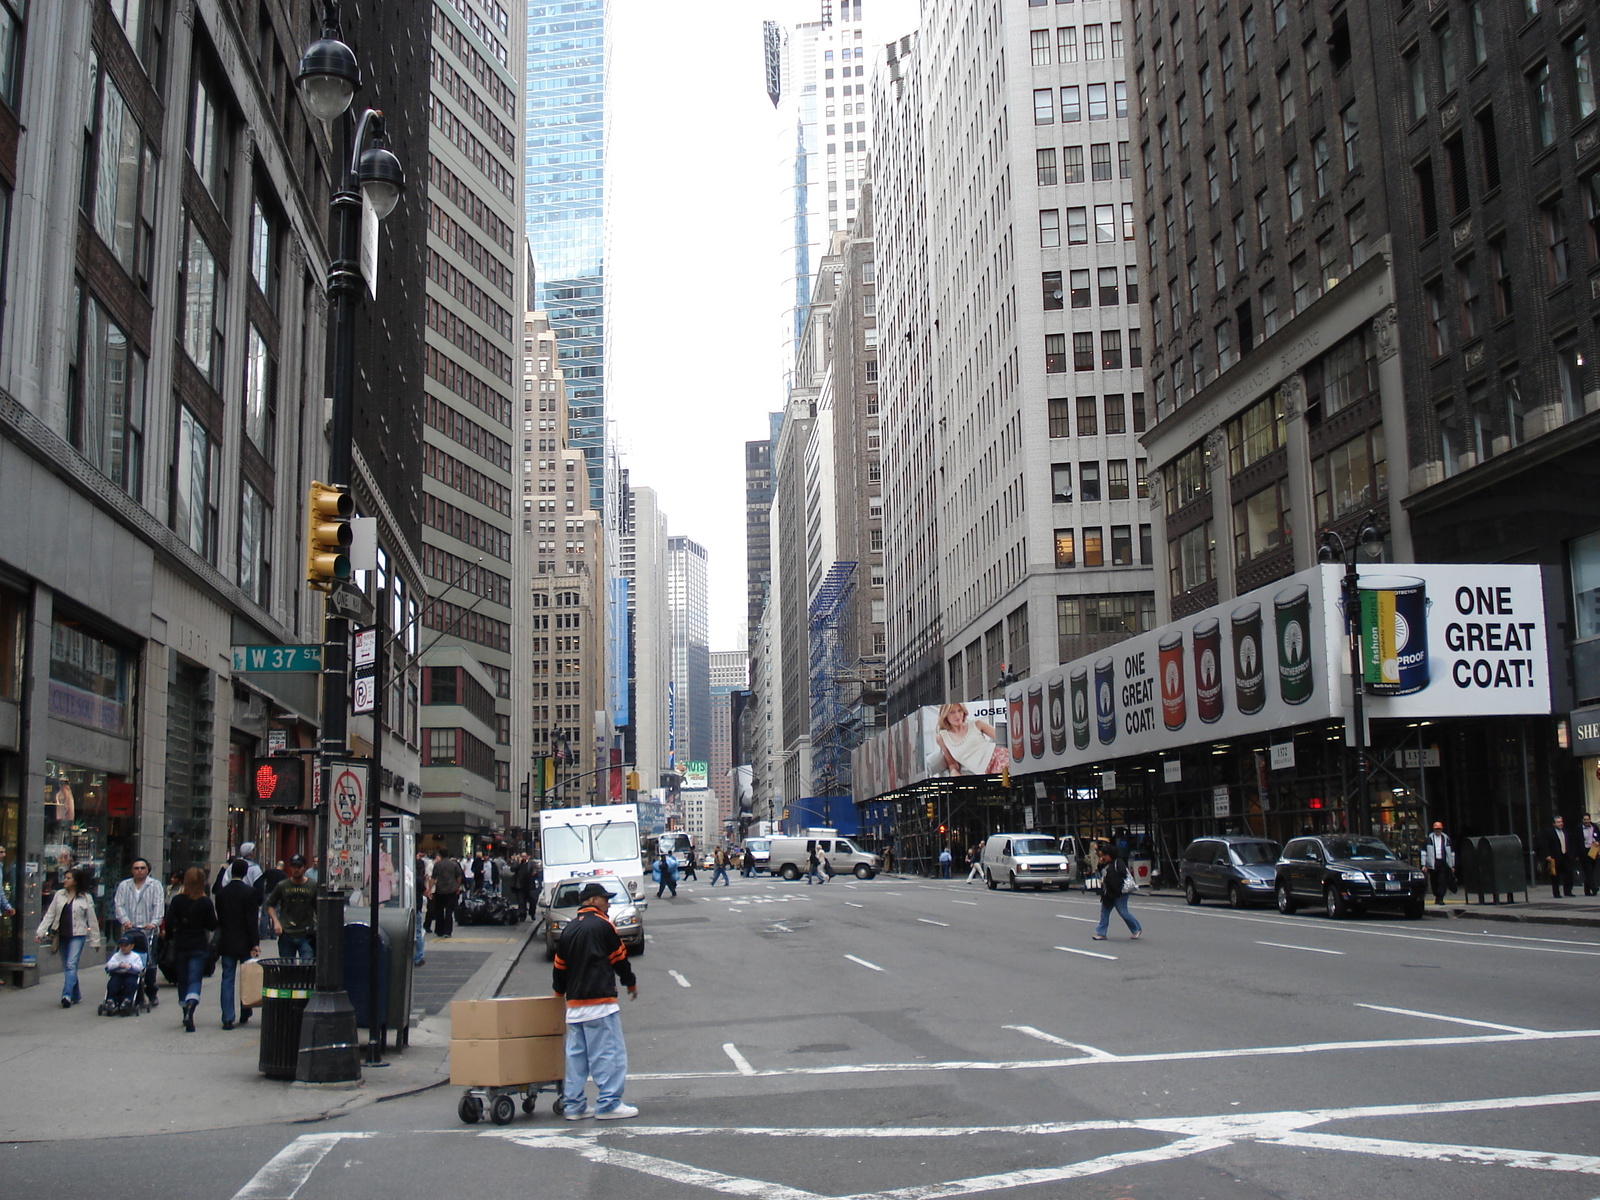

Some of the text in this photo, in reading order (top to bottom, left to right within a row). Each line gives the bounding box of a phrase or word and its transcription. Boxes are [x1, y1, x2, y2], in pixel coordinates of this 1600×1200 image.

[1369, 596, 1378, 627] district
[1455, 586, 1513, 615] ONE
[1370, 626, 1380, 665] fashion
[1445, 622, 1535, 652] GREAT
[251, 648, 318, 669] W 37 ST
[1125, 651, 1145, 679] ONE
[1280, 658, 1310, 676] WEATHERPROOF
[1452, 658, 1534, 688] COAT!
[1122, 677, 1154, 708] GREAT
[1125, 707, 1155, 735] COAT!
[570, 868, 614, 877] FedEx
